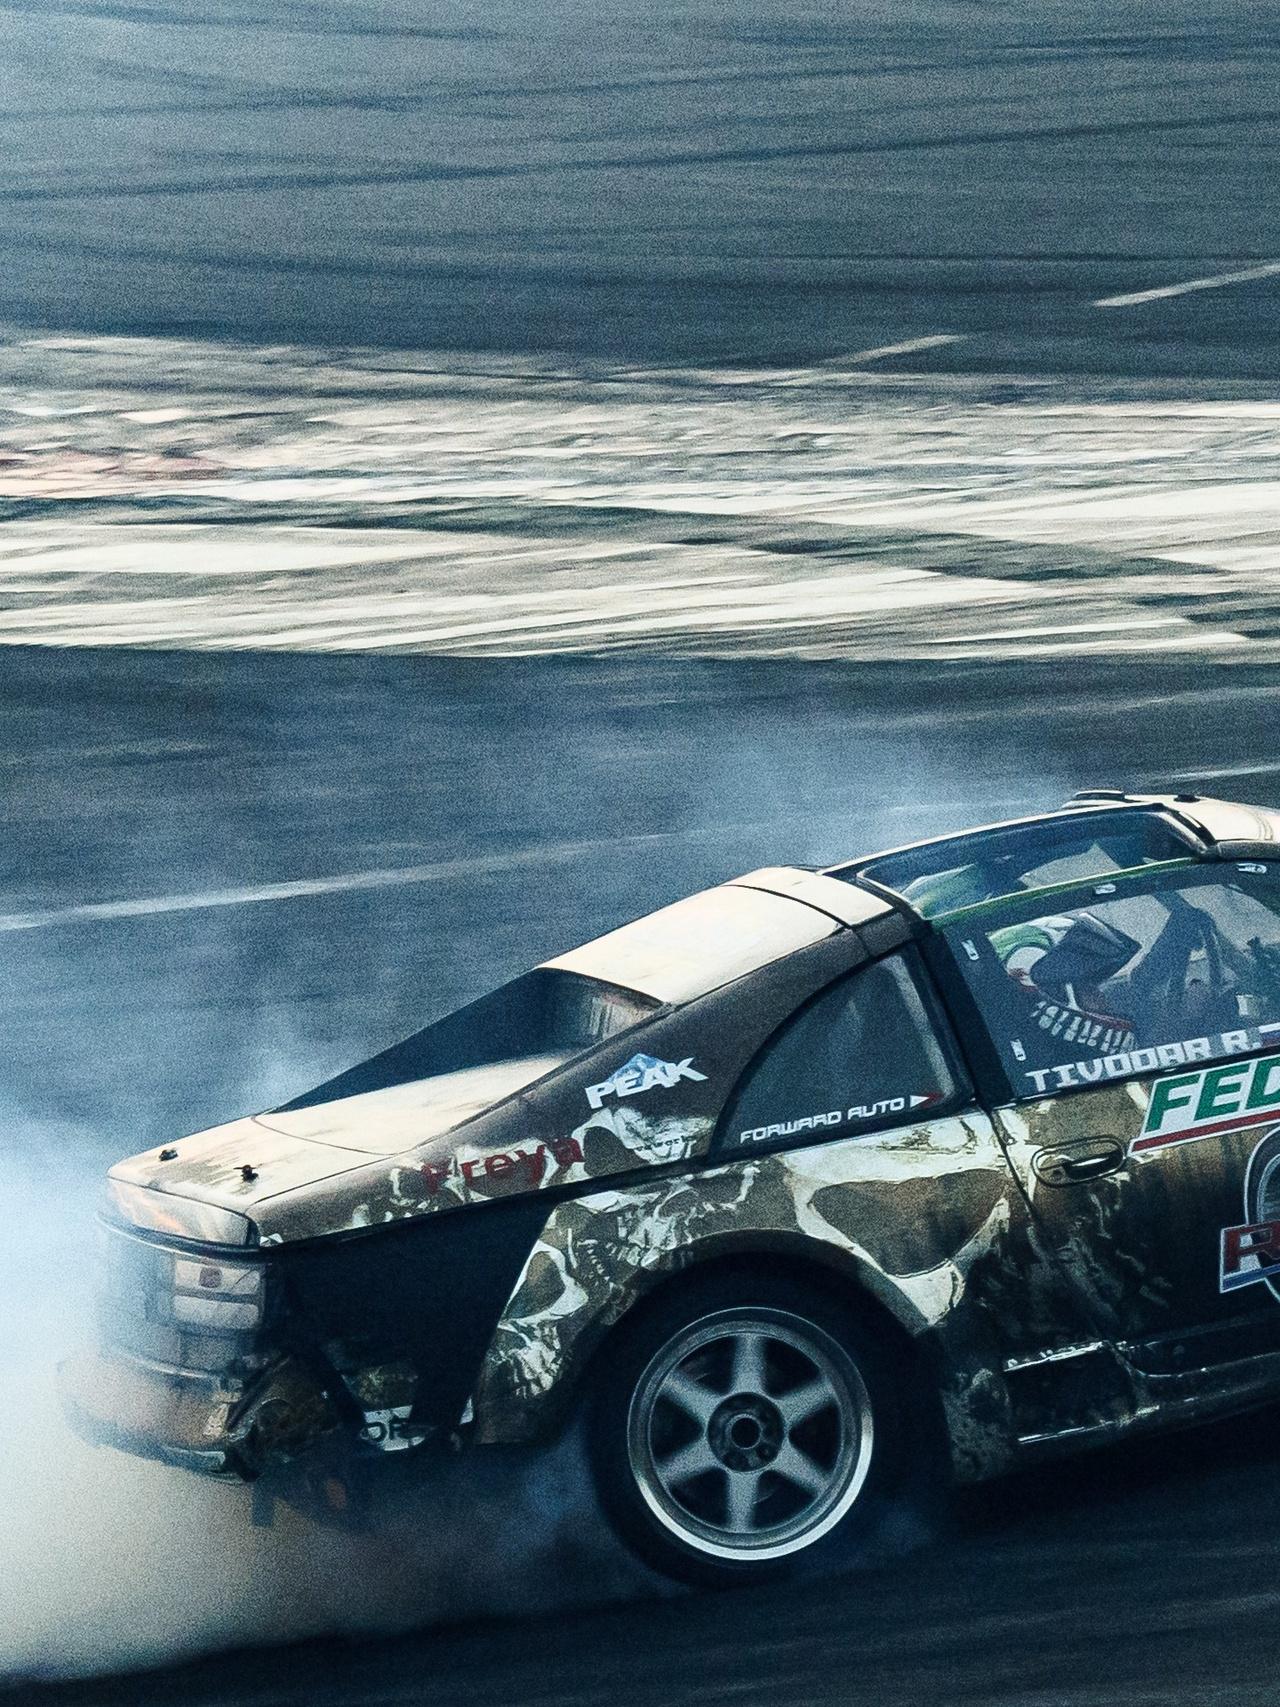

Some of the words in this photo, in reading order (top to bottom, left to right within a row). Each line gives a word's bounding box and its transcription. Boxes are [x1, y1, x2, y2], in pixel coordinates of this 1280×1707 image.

[585, 1057, 709, 1109] PEAK
[1025, 1037, 1211, 1092] TIVODAR
[740, 1110, 842, 1144] FORWARD
[847, 1097, 905, 1120] AUTO
[421, 1136, 585, 1194] Freya
